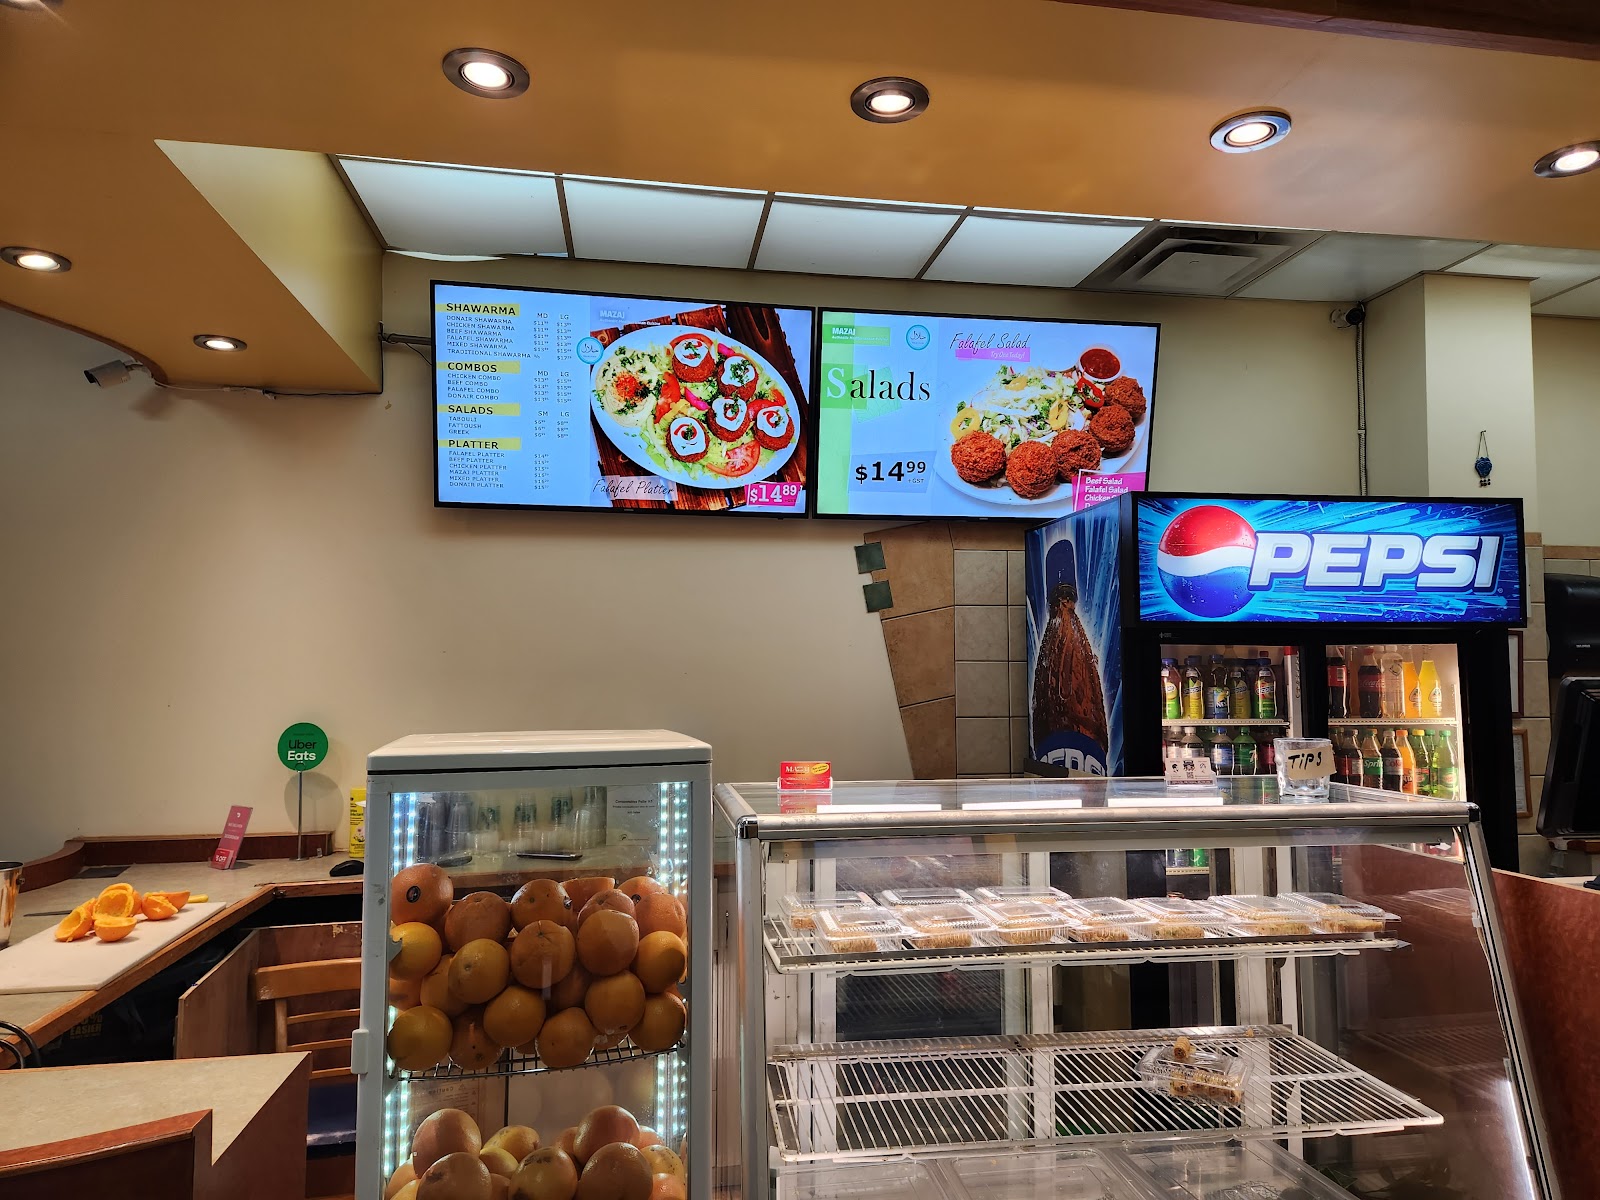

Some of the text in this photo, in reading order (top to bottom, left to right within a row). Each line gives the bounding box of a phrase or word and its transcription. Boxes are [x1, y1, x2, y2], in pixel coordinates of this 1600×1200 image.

[446, 302, 516, 315] SHAWARMA
[832, 327, 856, 336] MAZAJ
[470, 342, 508, 350] SHAWARMA
[949, 332, 1031, 355] Falafel Salad
[447, 362, 497, 373] COMBOS
[826, 367, 931, 401] Salads
[448, 404, 493, 415] SALADS
[448, 439, 499, 450] PLATTER
[1085, 477, 1123, 485] Beef Salad
[592, 478, 674, 498] Falafel Platter
[1248, 532, 1500, 588] PEPSI
[288, 739, 317, 749] Uber
[287, 750, 316, 761] Eats
[70, 1024, 102, 1035] EASIER
